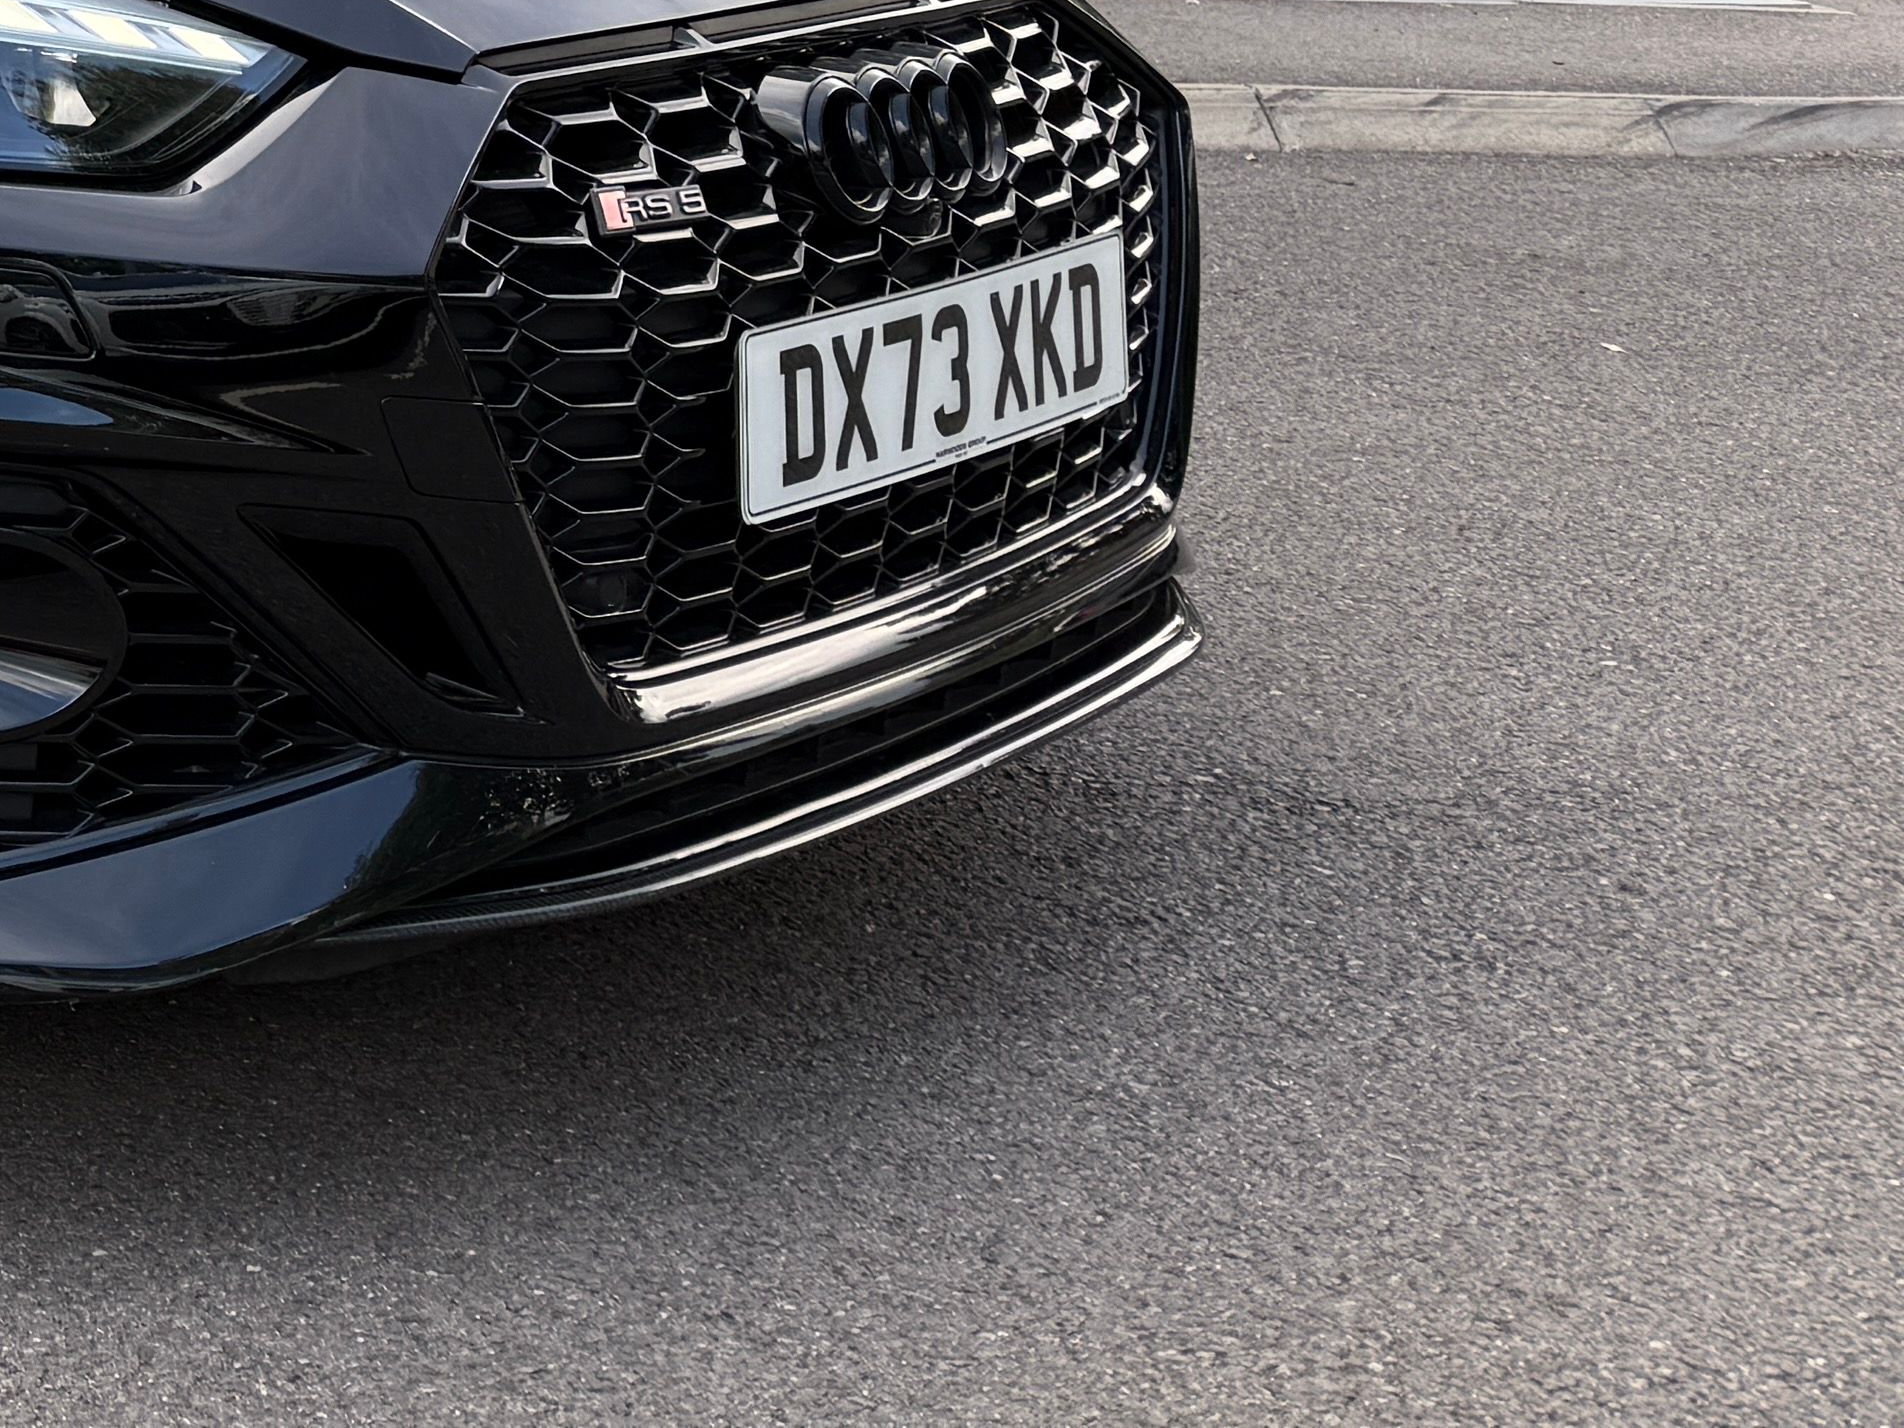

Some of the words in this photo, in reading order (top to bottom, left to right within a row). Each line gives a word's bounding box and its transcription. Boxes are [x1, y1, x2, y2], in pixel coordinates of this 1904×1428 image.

[616, 193, 672, 223] RS
[678, 189, 707, 214] 5
[779, 303, 971, 488] DX73
[989, 262, 1103, 422] XKD
